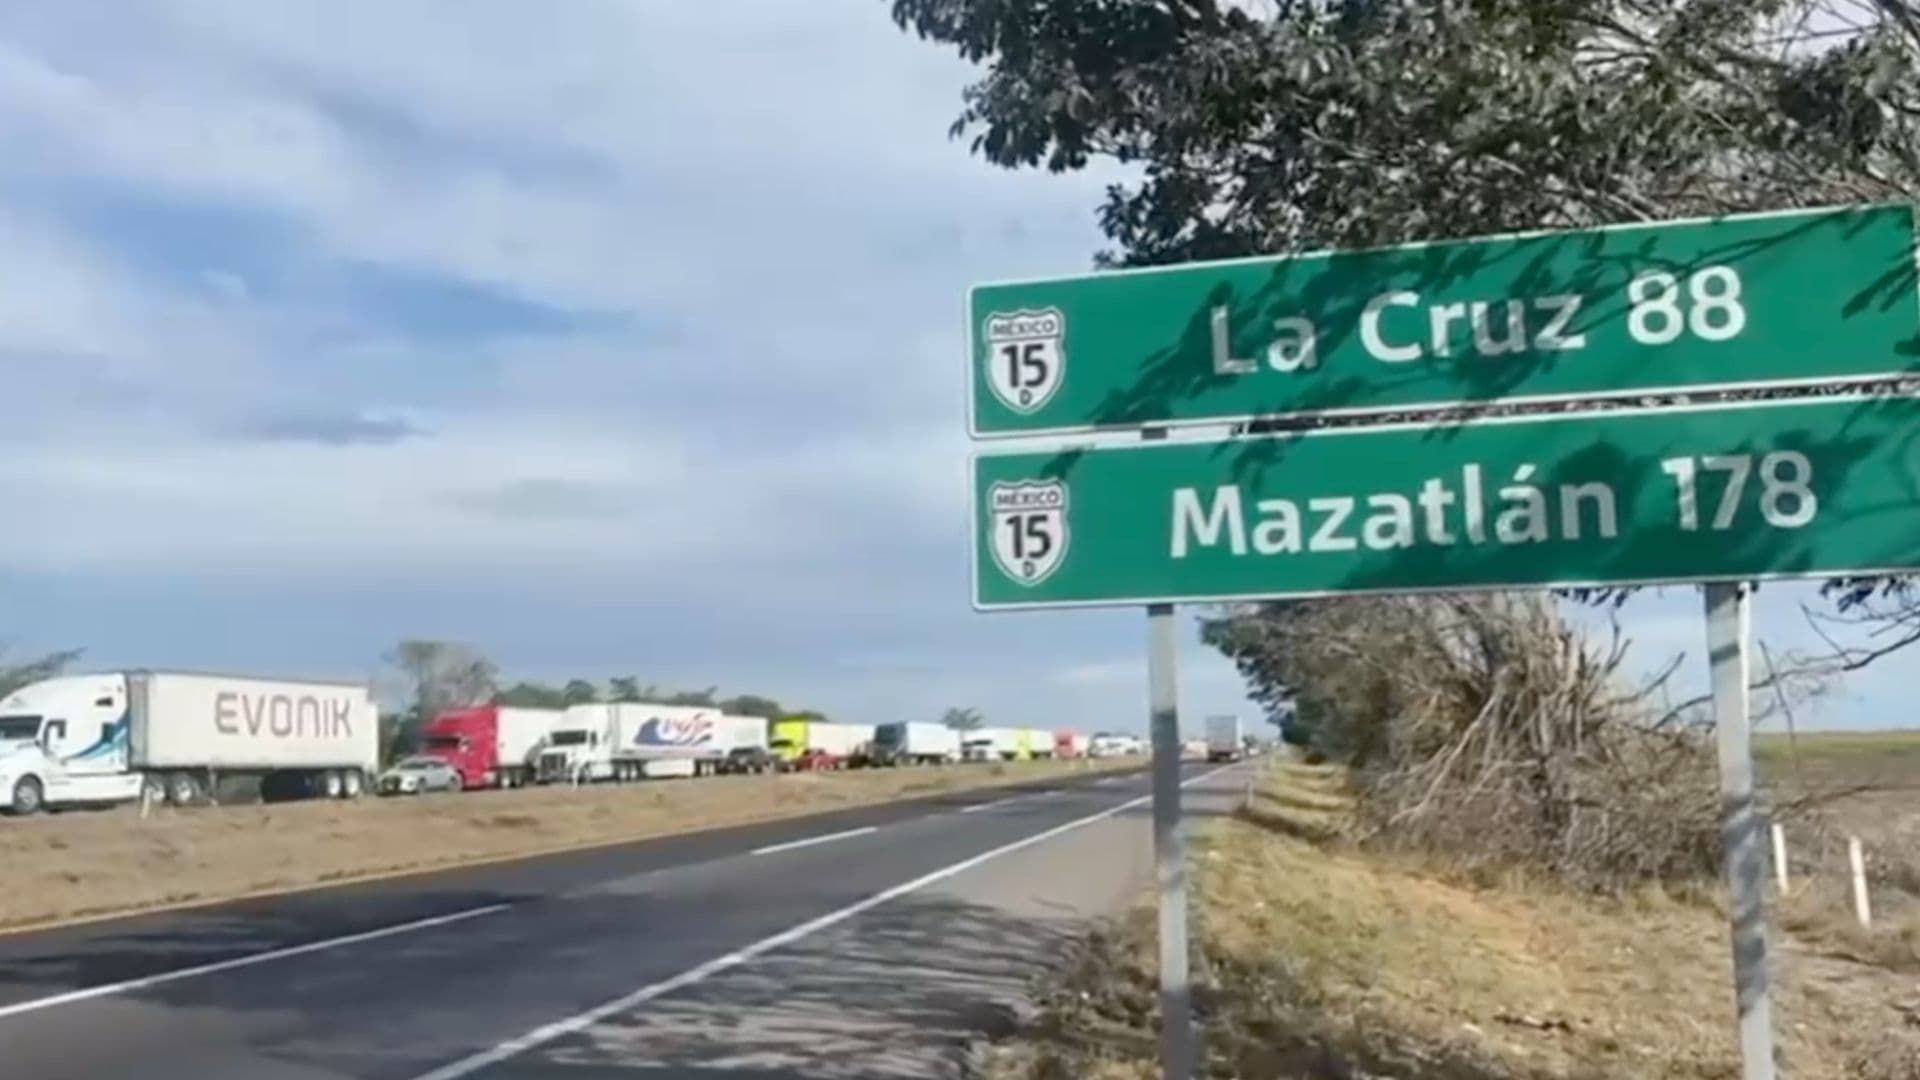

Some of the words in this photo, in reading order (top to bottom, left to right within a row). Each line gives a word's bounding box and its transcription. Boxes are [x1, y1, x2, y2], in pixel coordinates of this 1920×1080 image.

[1210, 304, 1319, 375] La
[1359, 289, 1586, 362] Cruz
[1627, 265, 1746, 345] 88
[1001, 342, 1049, 388] 15
[1019, 388, 1033, 406] D
[1169, 463, 1618, 558] Mazatlán
[1661, 449, 1817, 531] 178
[1005, 514, 1052, 560] 15
[1022, 560, 1036, 578] D
[214, 691, 353, 738] EVONIK
